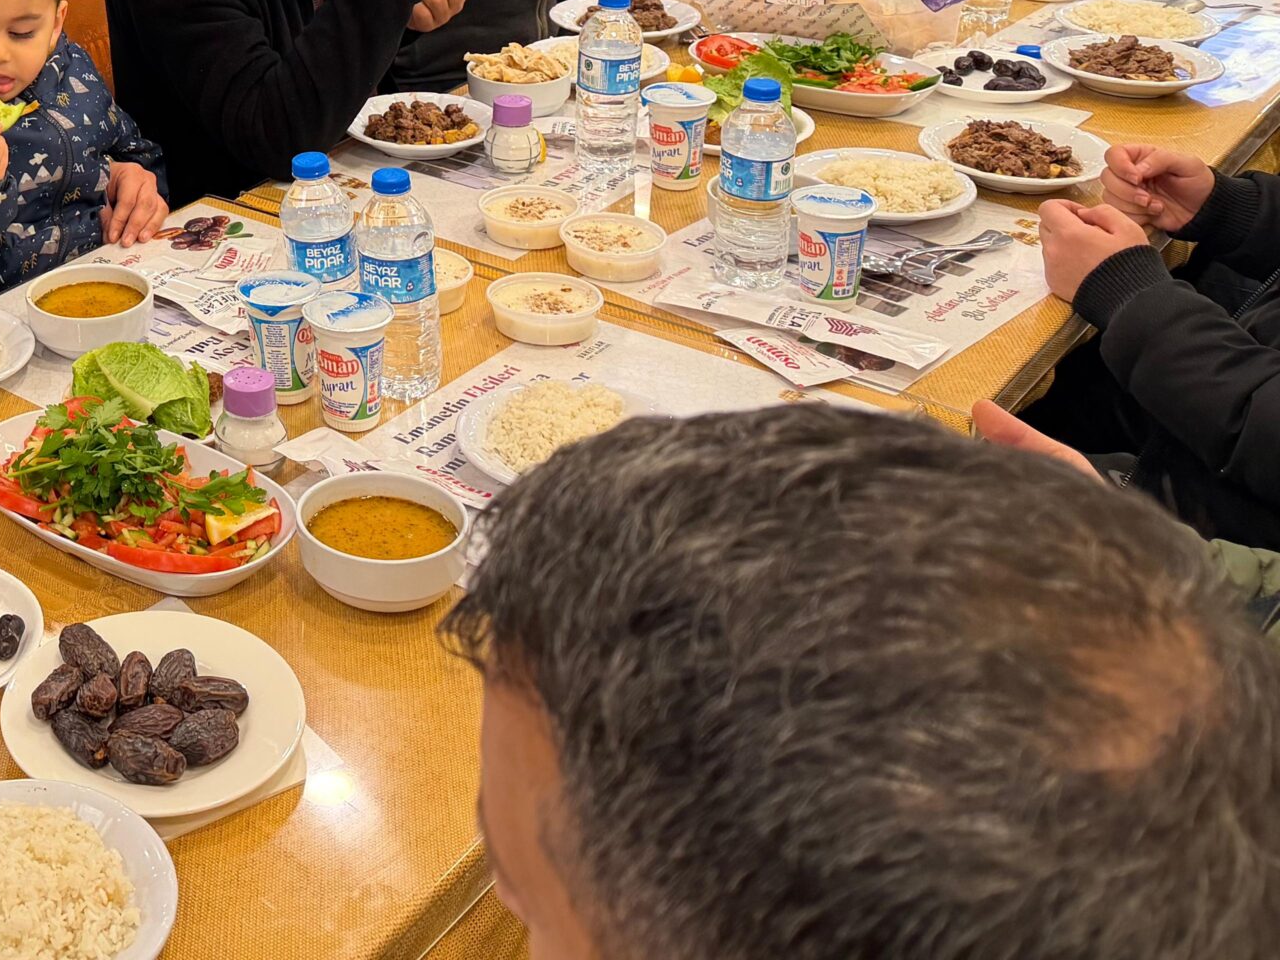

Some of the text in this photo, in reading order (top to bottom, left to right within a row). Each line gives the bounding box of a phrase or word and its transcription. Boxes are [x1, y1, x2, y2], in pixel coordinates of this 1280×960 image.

[306, 244, 342, 257] BEYAZ
[305, 254, 345, 269] PINAR
[363, 262, 399, 276] BEYAZ
[363, 274, 402, 289] PINAR
[393, 397, 471, 446] Emanetin
